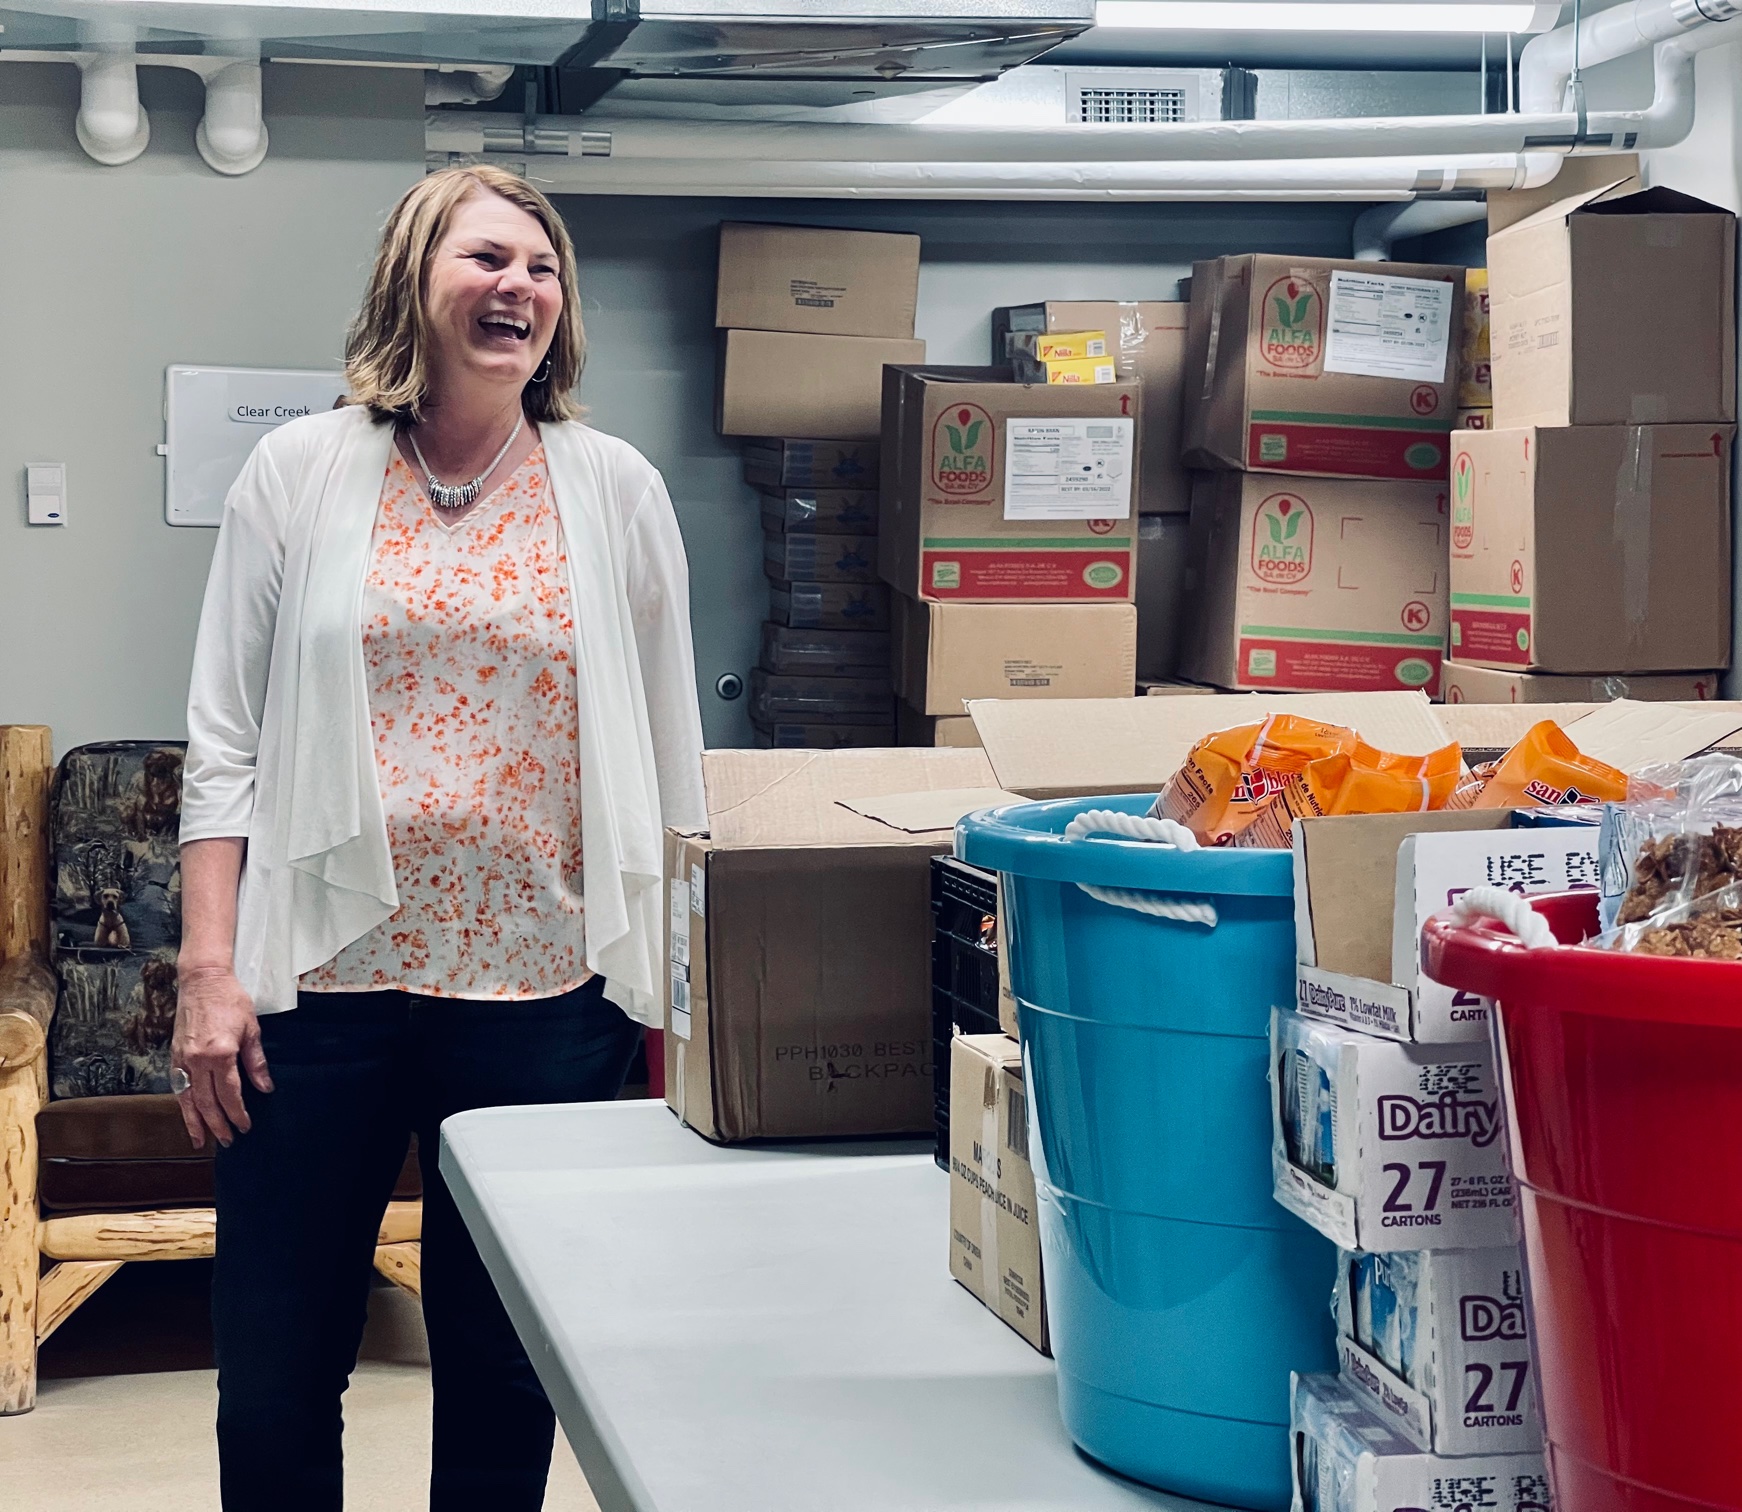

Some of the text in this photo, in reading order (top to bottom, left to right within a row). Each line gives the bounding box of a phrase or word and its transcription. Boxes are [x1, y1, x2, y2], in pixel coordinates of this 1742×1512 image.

[1268, 329, 1314, 345] ALFA
[1054, 349, 1072, 358] Nilla
[1267, 343, 1314, 356] FOODS
[1062, 375, 1080, 383] Nilla
[237, 405, 311, 418] Clear Creek
[940, 456, 987, 471] ALFA
[939, 471, 987, 483] FOODS
[1260, 544, 1306, 561] ALFA
[1258, 559, 1306, 573] FOODS
[1195, 768, 1214, 795] Facts
[1528, 780, 1563, 803] san
[1486, 852, 1550, 887] USE
[1309, 982, 1346, 1013] DairyPure
[1359, 998, 1382, 1019] Lowfat
[1382, 1004, 1397, 1024] Milk
[775, 1039, 929, 1062] PPH1030 BEST
[1377, 1090, 1500, 1148] Dairy
[1382, 1160, 1447, 1213] 27
[1451, 1177, 1462, 1187] 27
[1477, 1175, 1489, 1185] FL
[1490, 1175, 1505, 1185] OZ
[967, 1167, 979, 1189] CUPS
[979, 1176, 995, 1202] PEACH
[1013, 1202, 1029, 1226] JUICE
[1451, 1199, 1470, 1209] NET
[1489, 1198, 1501, 1208] FL
[1381, 1213, 1442, 1228] CARTONS
[1464, 1362, 1528, 1414] 27
[1463, 1414, 1523, 1428] CARTONS
